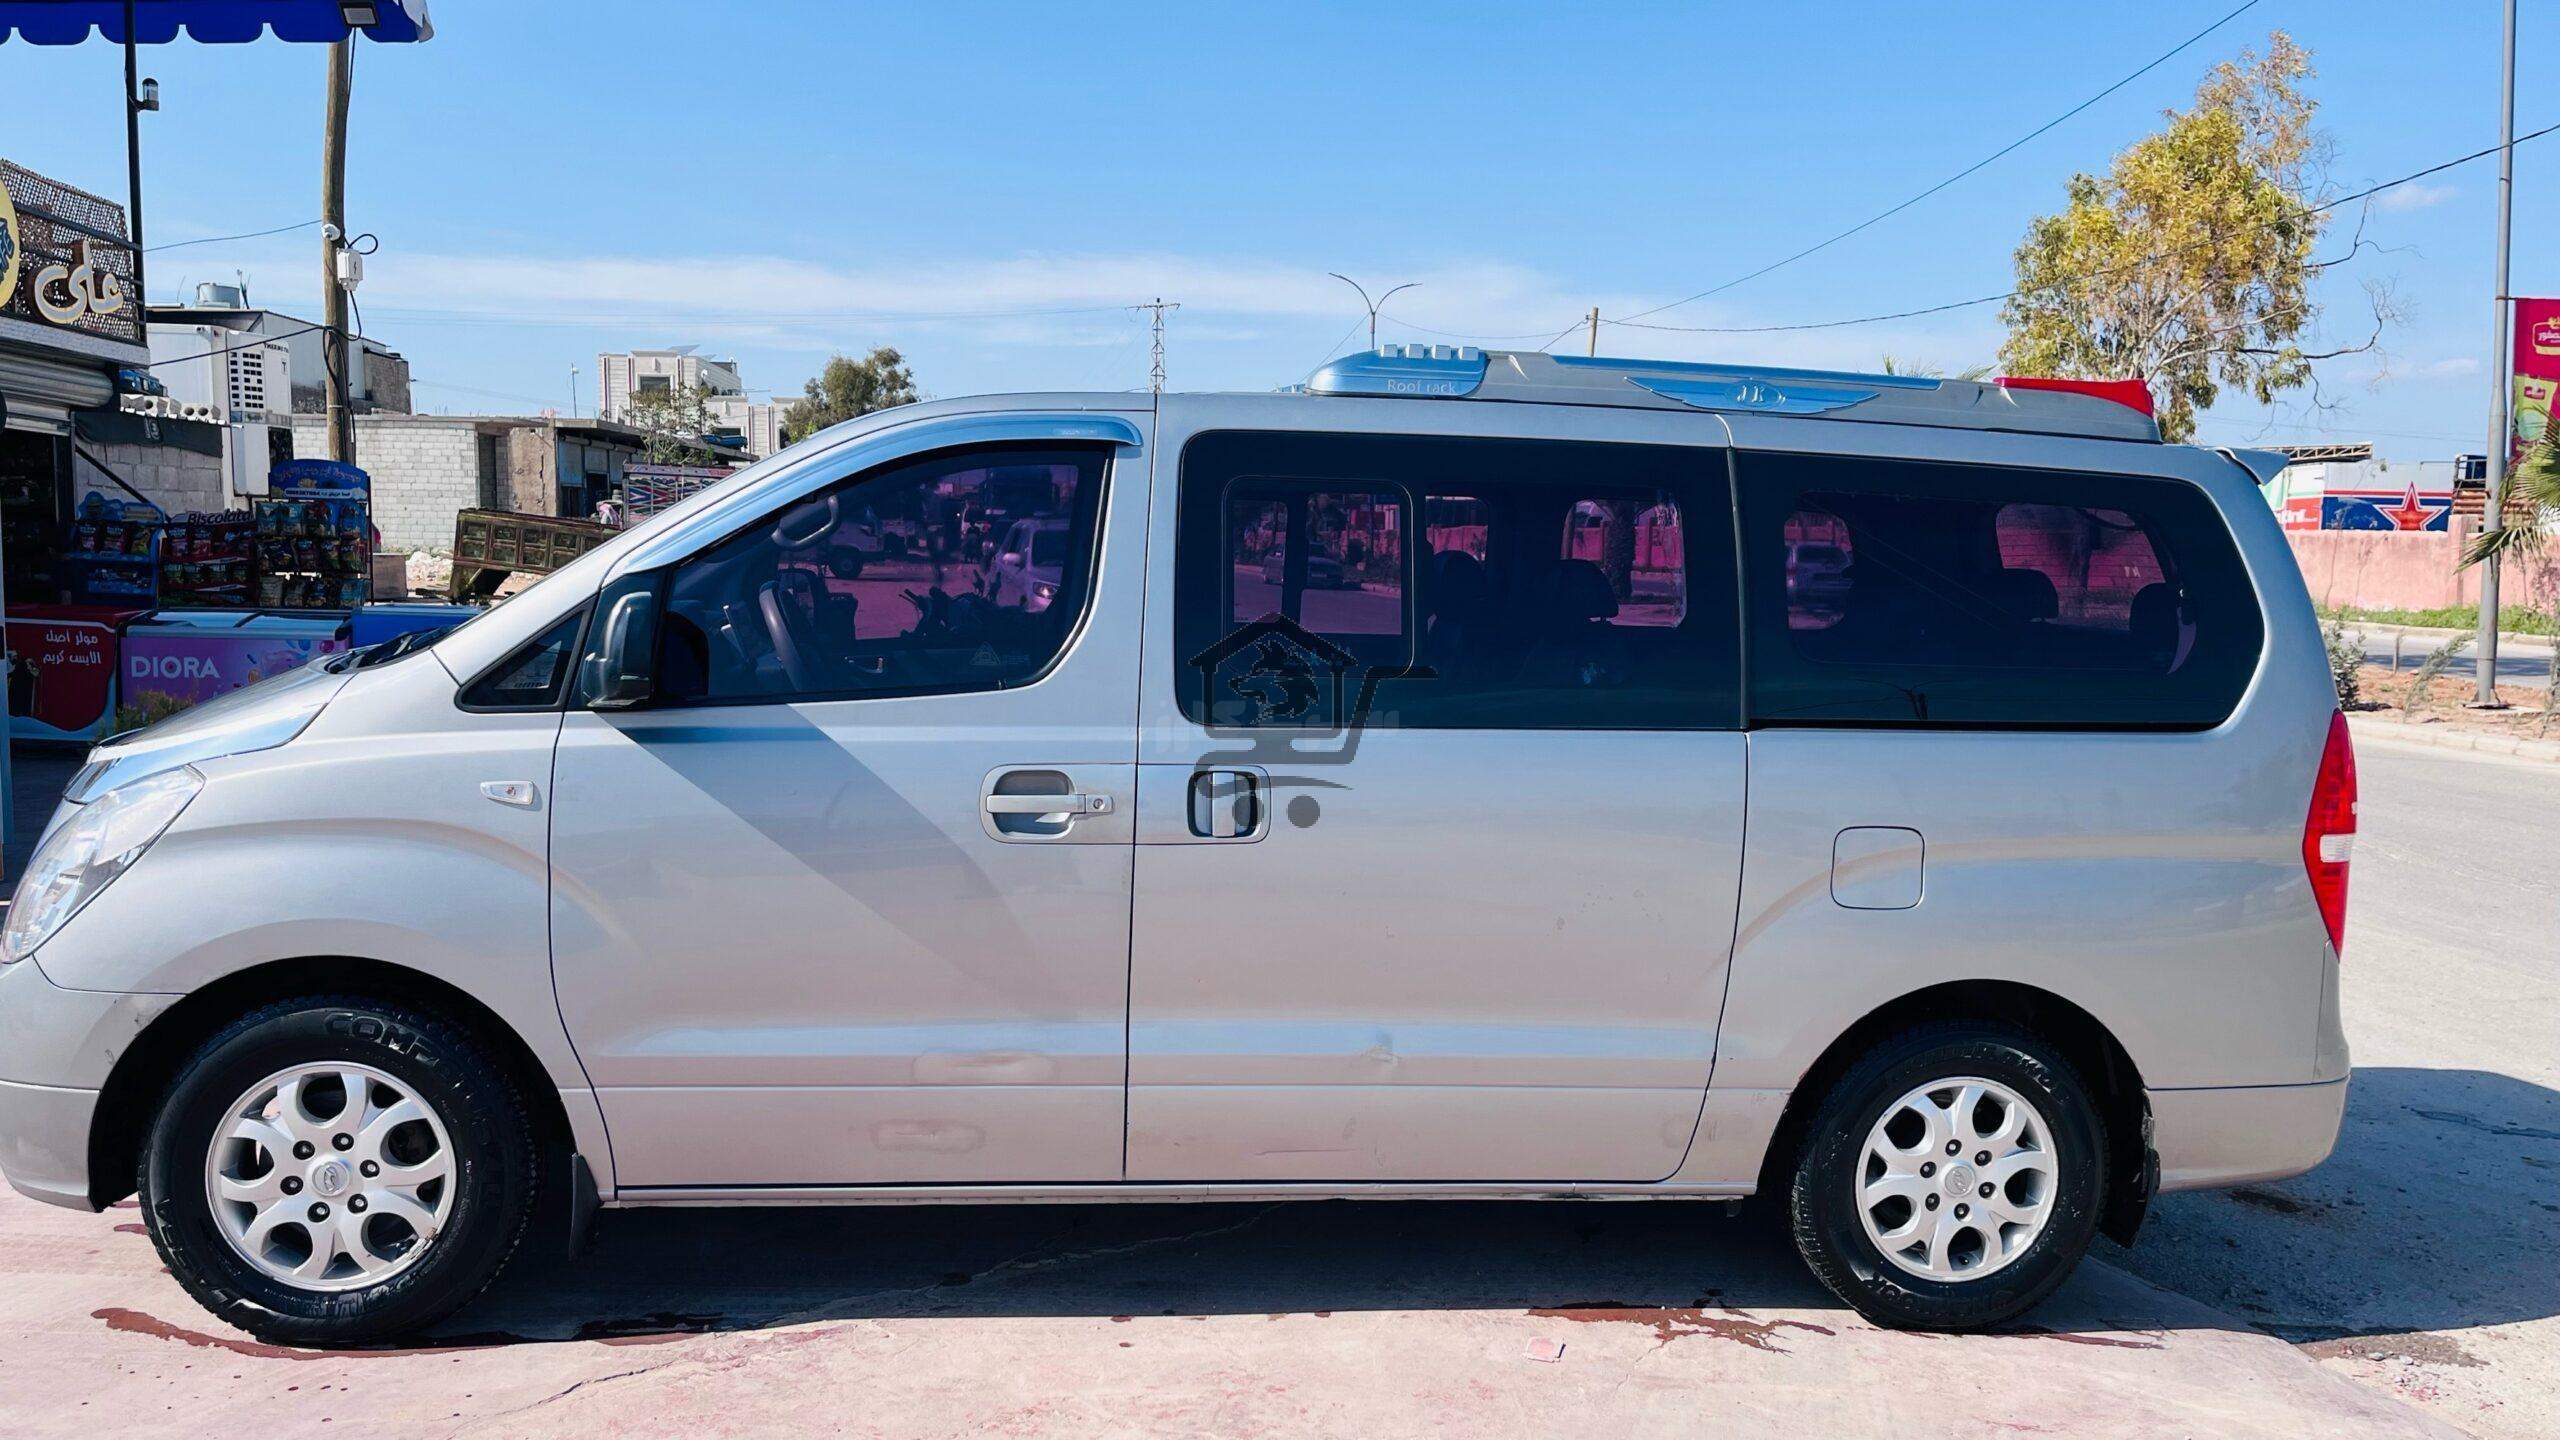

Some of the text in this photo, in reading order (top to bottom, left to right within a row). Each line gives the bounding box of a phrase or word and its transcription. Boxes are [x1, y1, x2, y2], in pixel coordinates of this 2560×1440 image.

[1387, 378, 1457, 394] Roof rack
[188, 508, 254, 528] Biscolata
[130, 655, 221, 679] DIORA
